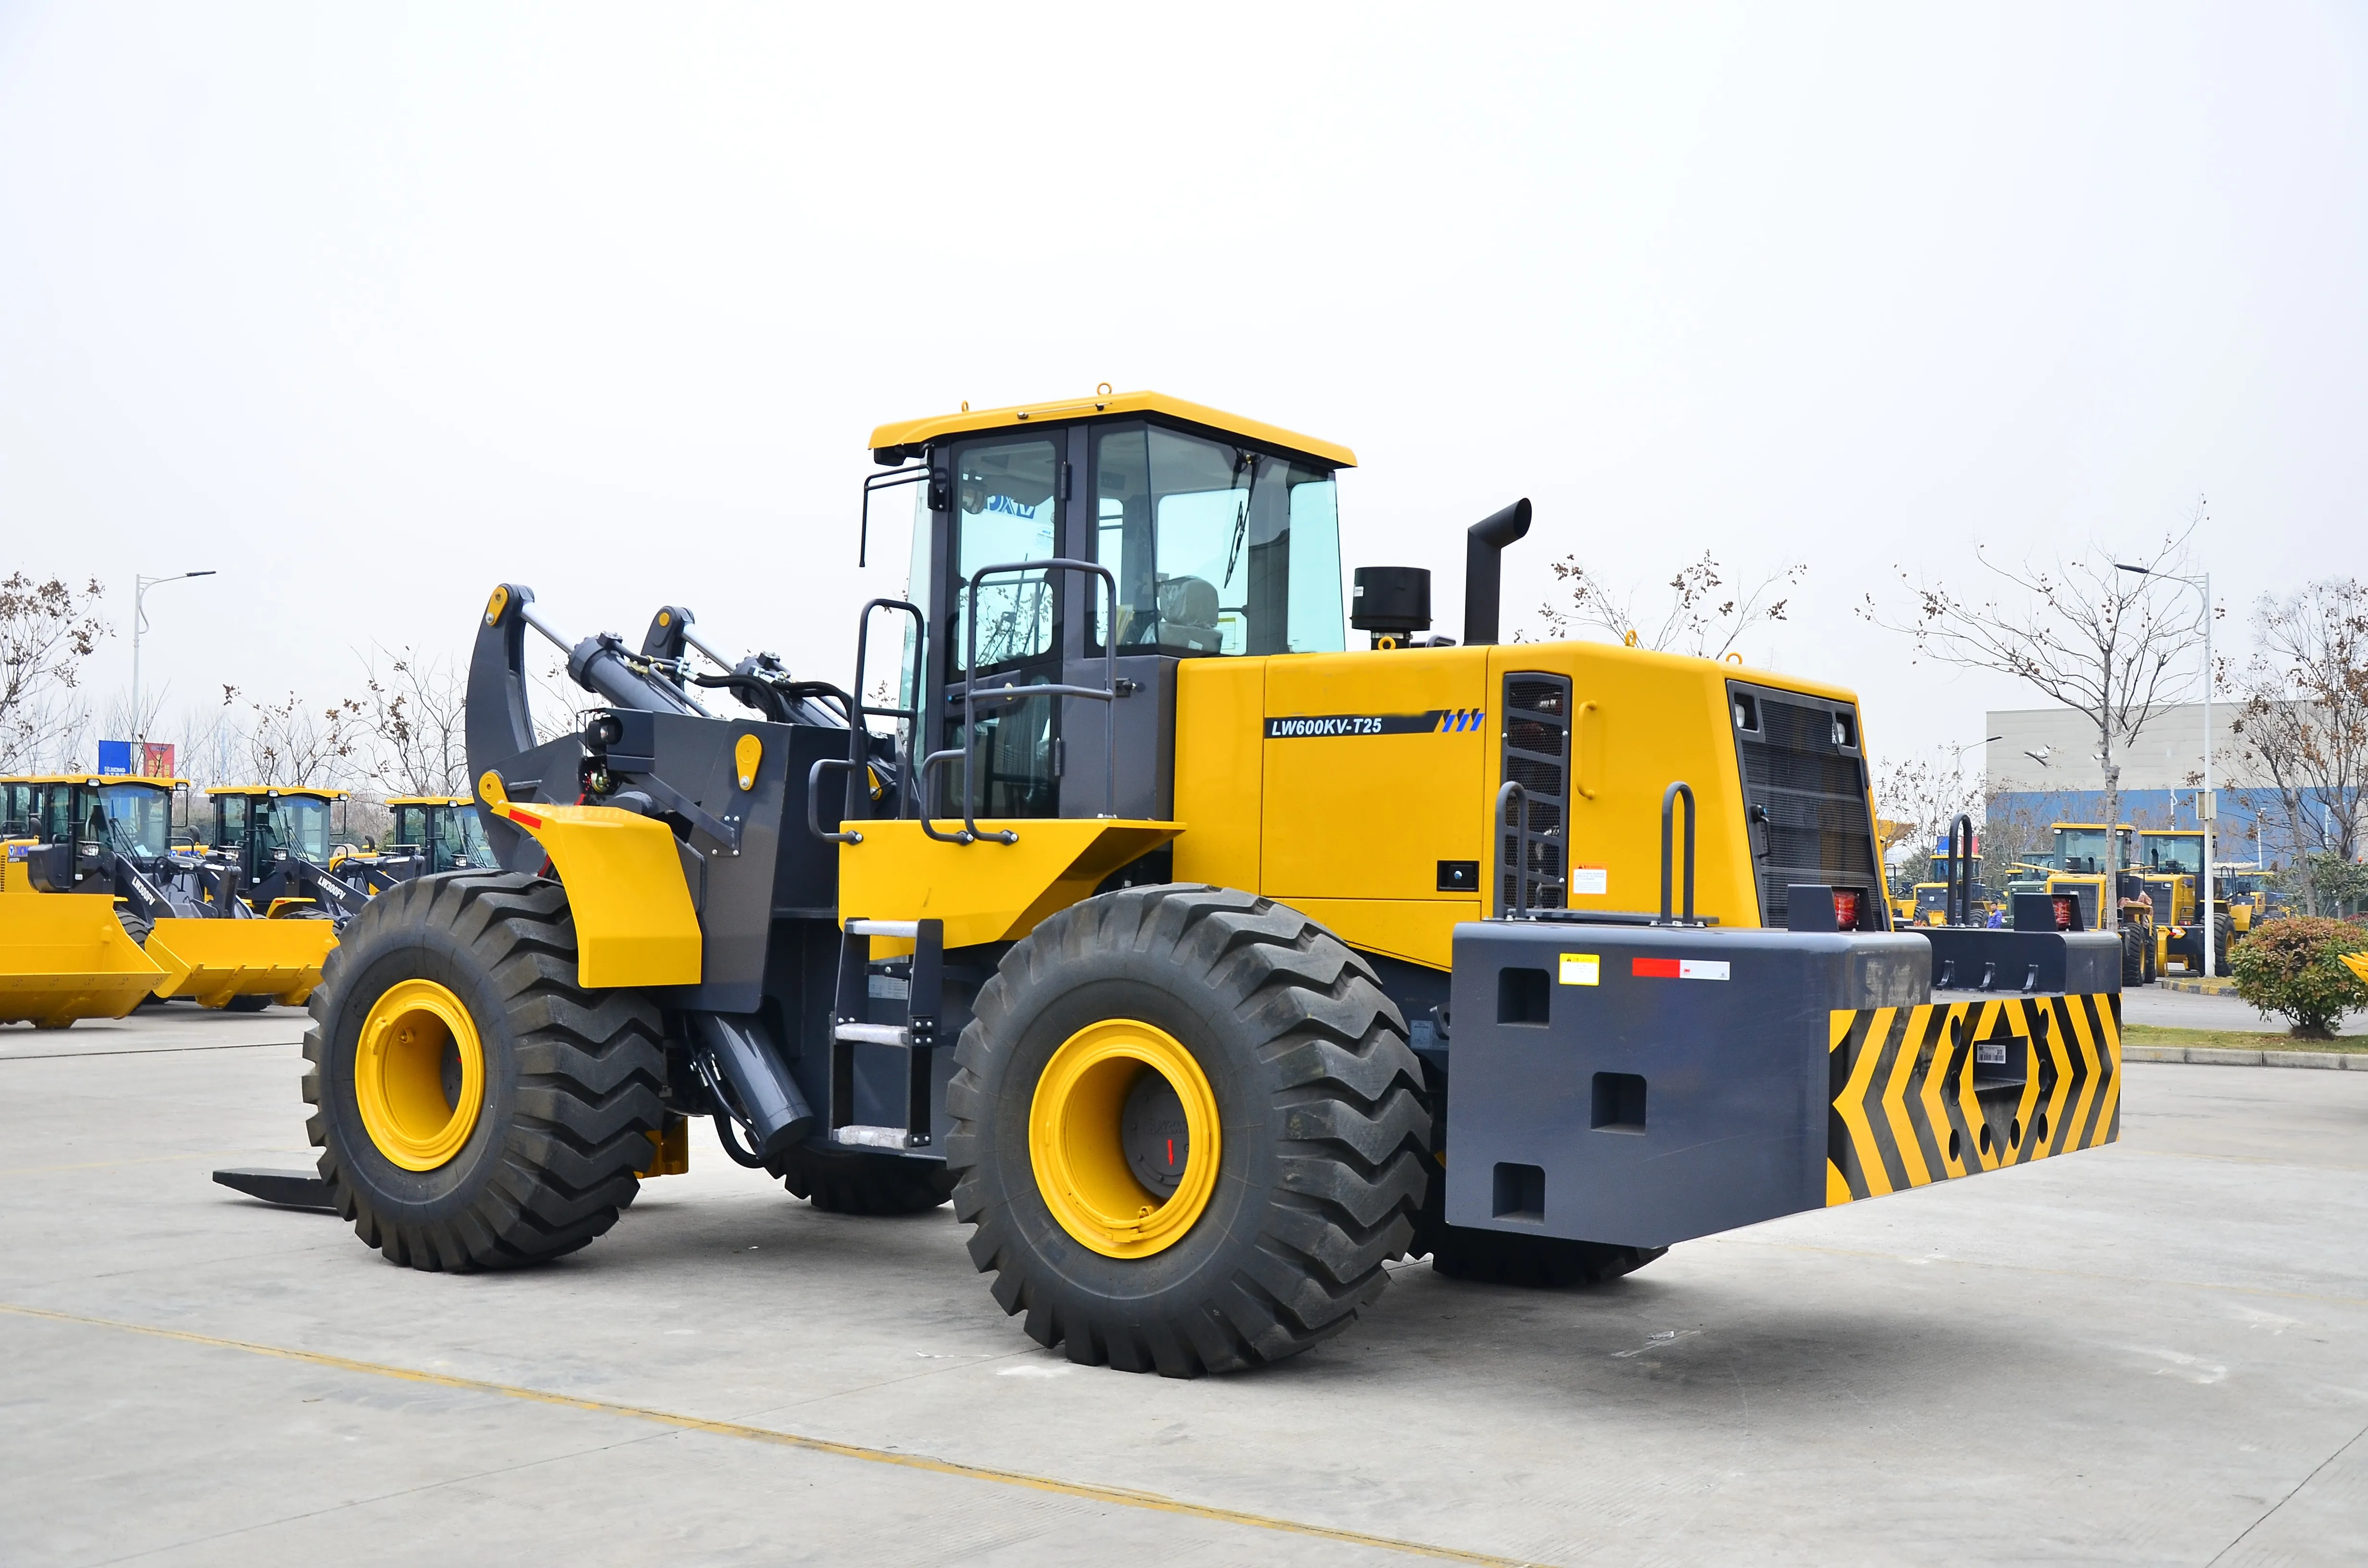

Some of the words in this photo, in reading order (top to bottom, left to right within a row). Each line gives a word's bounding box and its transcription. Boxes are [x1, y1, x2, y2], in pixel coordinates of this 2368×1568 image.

[1271, 717, 1382, 736] LW600KV-T25
[132, 876, 156, 906] LW300FV
[317, 876, 346, 900] LW300FV
